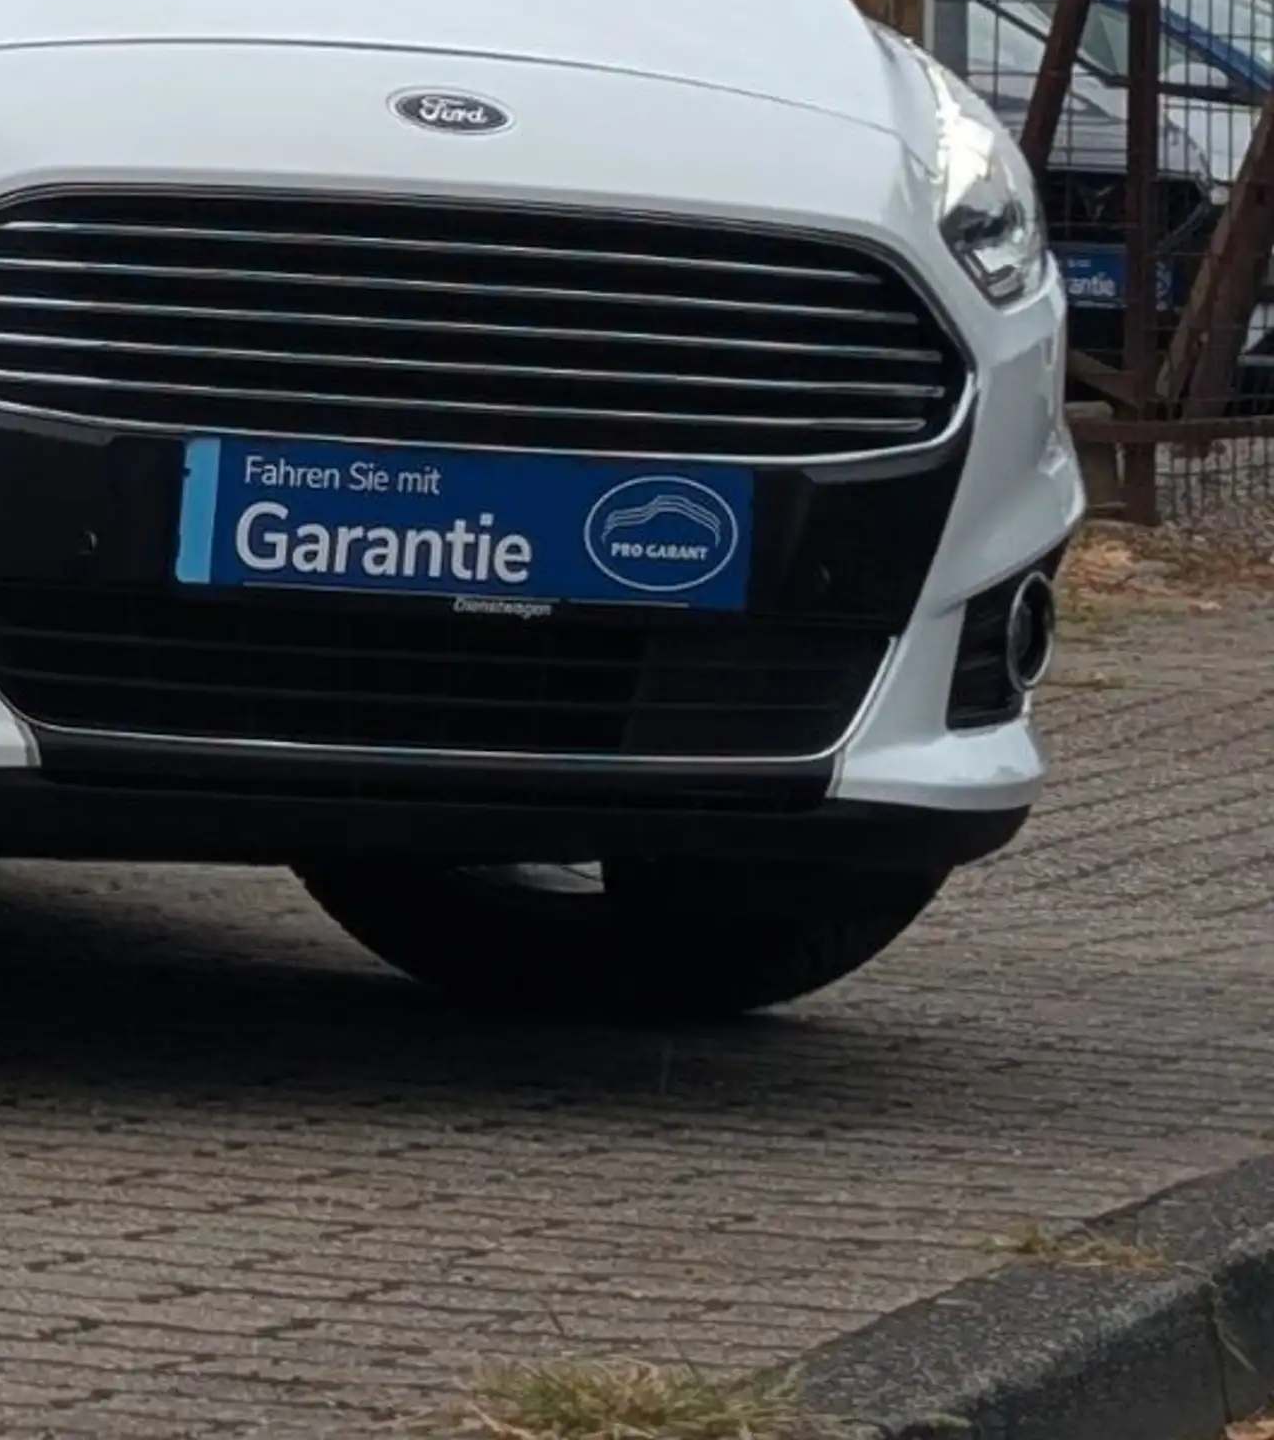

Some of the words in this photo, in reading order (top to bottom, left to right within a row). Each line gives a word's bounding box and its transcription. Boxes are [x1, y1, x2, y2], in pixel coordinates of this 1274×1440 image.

[418, 95, 487, 123] Ford
[244, 455, 340, 491] Fahren
[349, 461, 389, 492] Sie
[398, 467, 441, 495] mit
[235, 501, 532, 583] Garantie
[611, 542, 644, 558] PRO
[645, 544, 709, 561] GARANT
